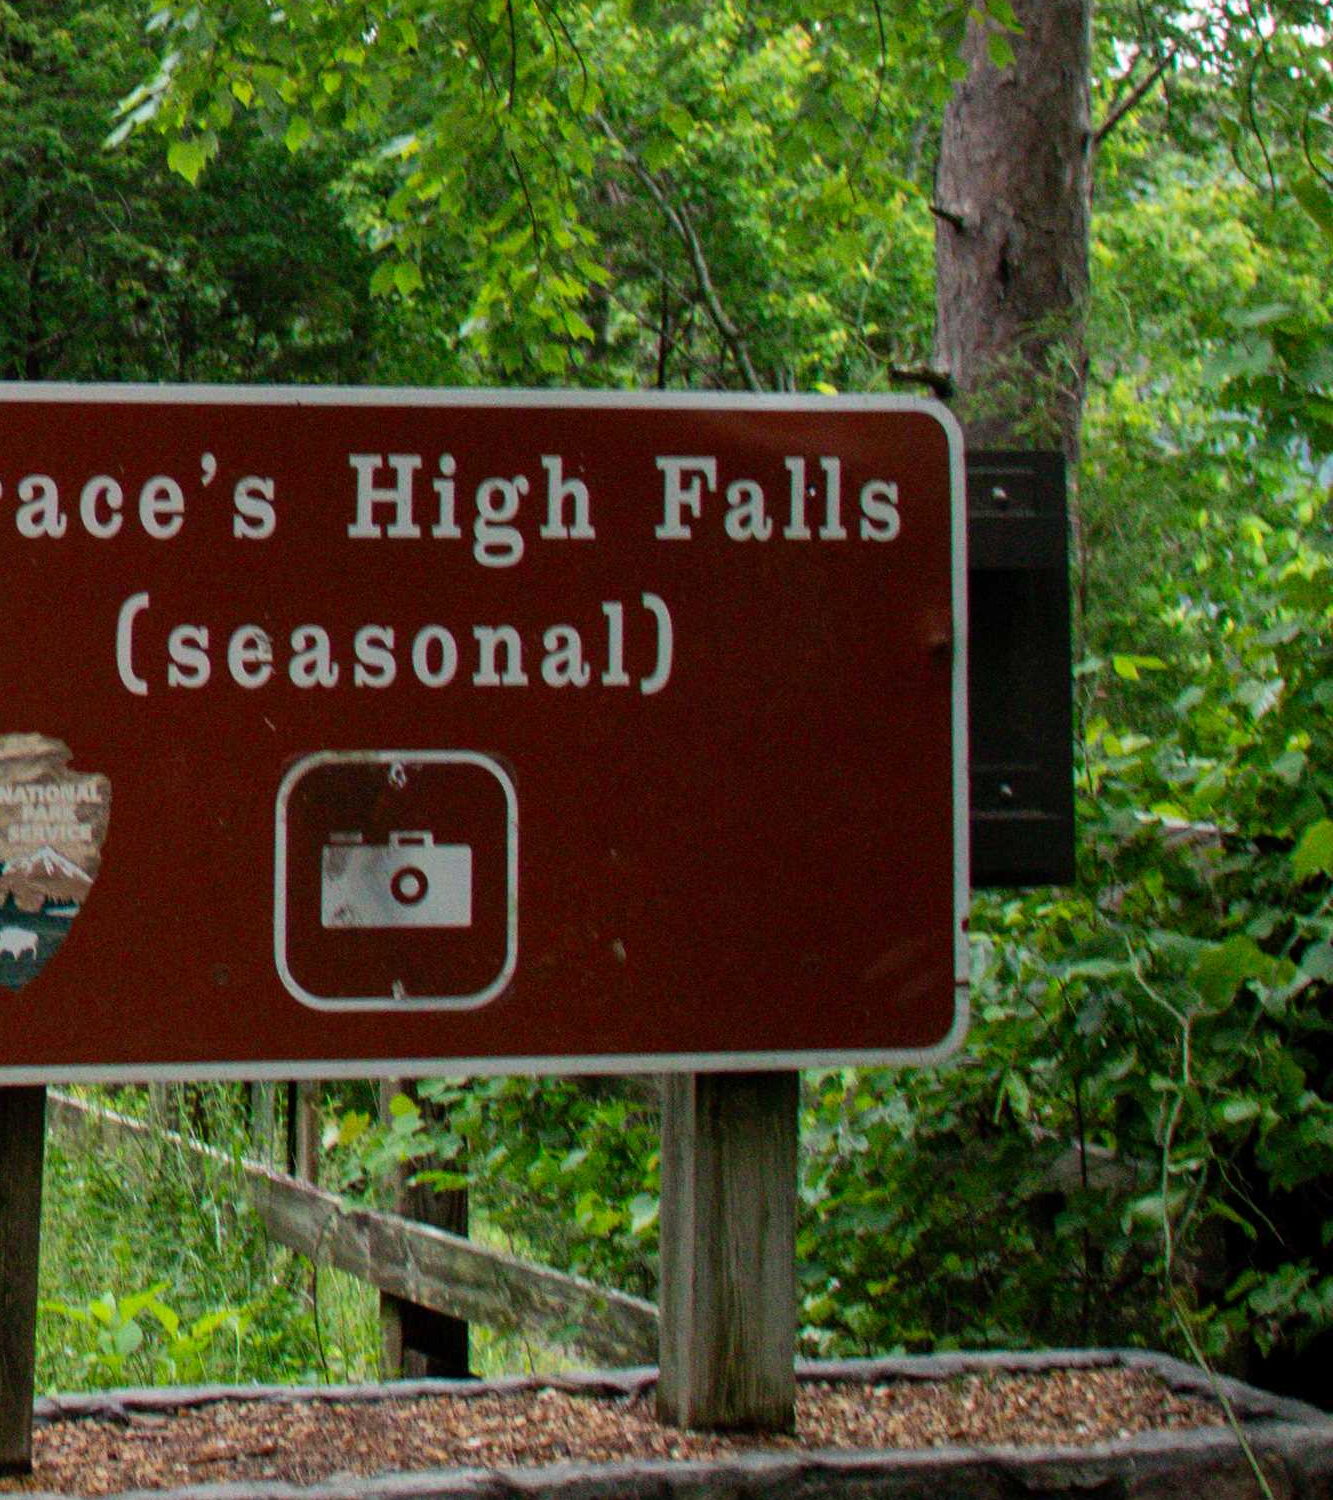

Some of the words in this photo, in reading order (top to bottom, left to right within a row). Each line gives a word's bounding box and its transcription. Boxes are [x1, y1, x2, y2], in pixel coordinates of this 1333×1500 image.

[348, 455, 596, 567] High
[655, 456, 902, 542] Falls
[116, 593, 674, 696] (seasonal)
[8, 823, 93, 843] SERVICE
[21, 804, 77, 824] PARK
